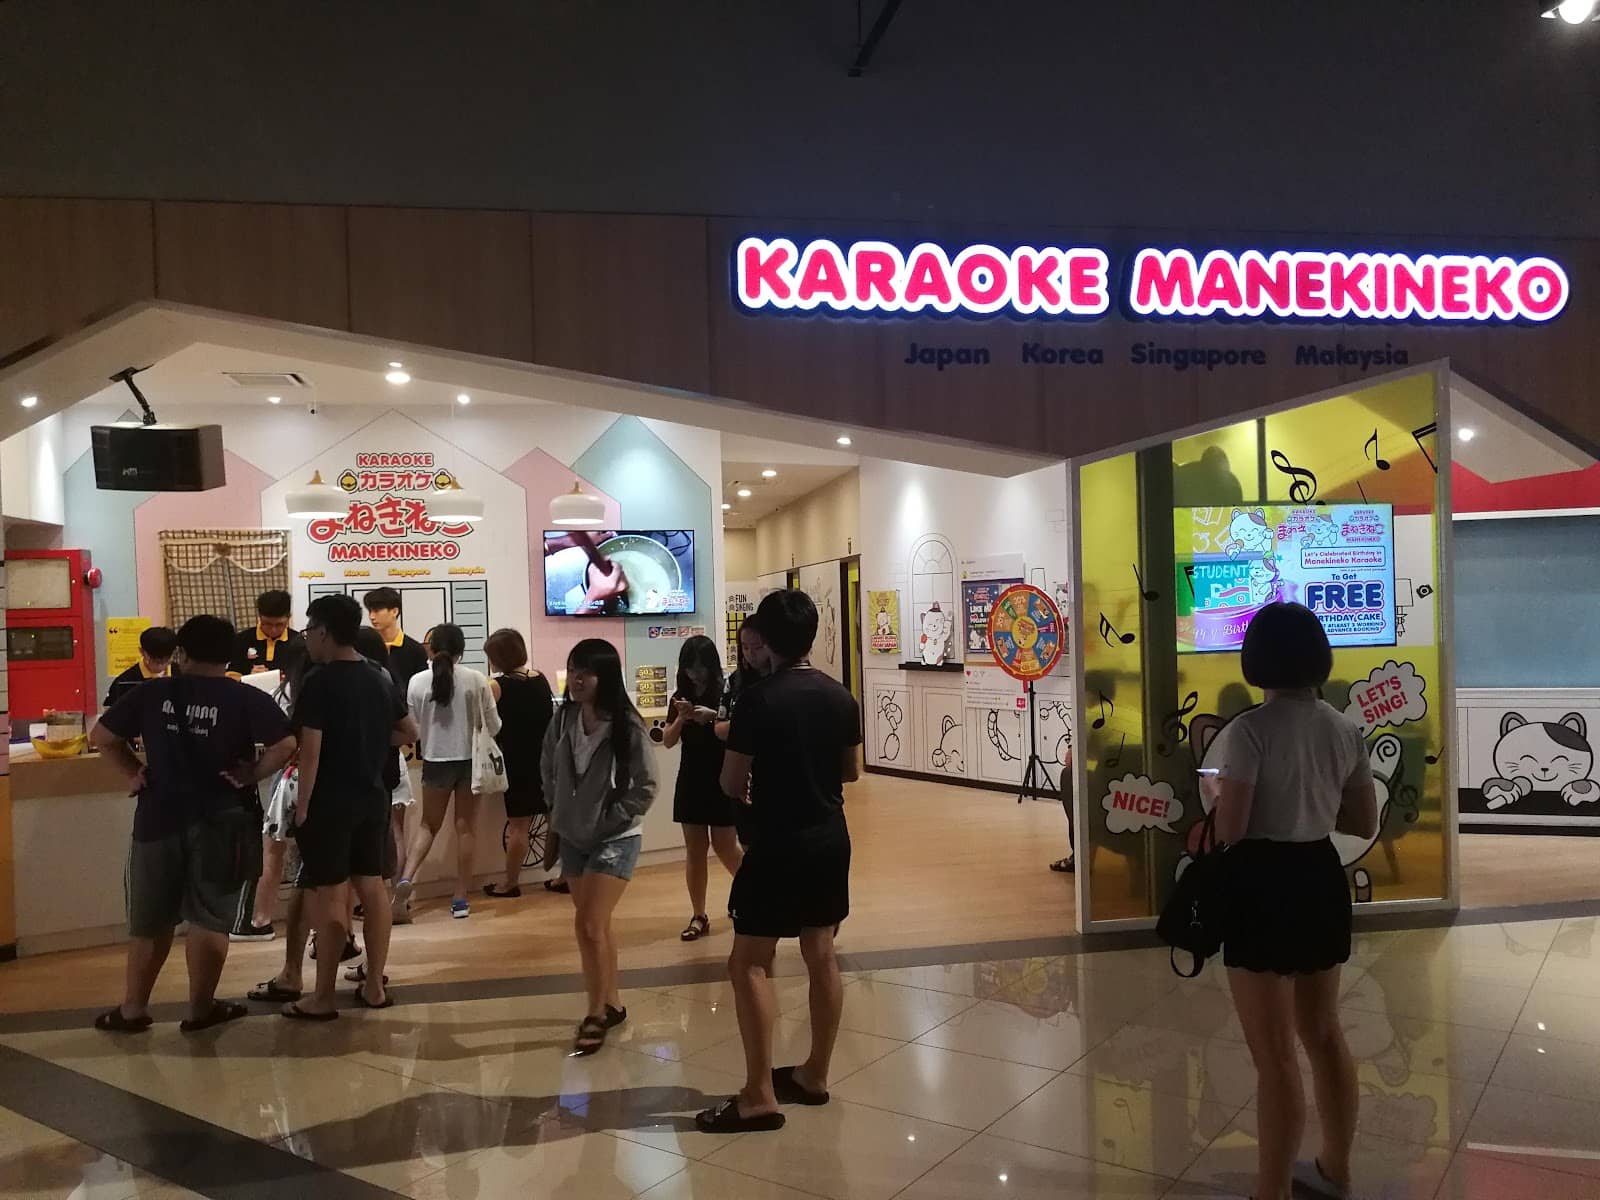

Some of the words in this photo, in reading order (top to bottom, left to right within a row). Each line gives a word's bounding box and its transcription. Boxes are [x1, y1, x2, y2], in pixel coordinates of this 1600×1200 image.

[736, 238, 1109, 316] KARAOKE
[1130, 249, 1571, 323] MANEKINEKO
[905, 343, 990, 371] Japan
[1022, 343, 1104, 366] Korea
[1131, 342, 1266, 371] Singapore
[1295, 344, 1410, 369] Malaysia
[357, 454, 433, 467] KARAOKE
[360, 473, 432, 491] カラオケ
[329, 542, 460, 561] MANEKINEKO
[1305, 557, 1350, 566] Manekineko
[1352, 556, 1383, 564] Karaoke
[1193, 564, 1247, 580] STUDENT
[1332, 573, 1341, 581] To
[1343, 573, 1358, 581] Get
[735, 594, 747, 603] FUN
[1307, 583, 1383, 609] FREE
[1317, 615, 1355, 623] RTHDAY
[1357, 613, 1381, 621] CAKE
[1357, 676, 1401, 708] LET'S
[1364, 692, 1408, 723] SING!
[1113, 791, 1170, 818] NICE!
